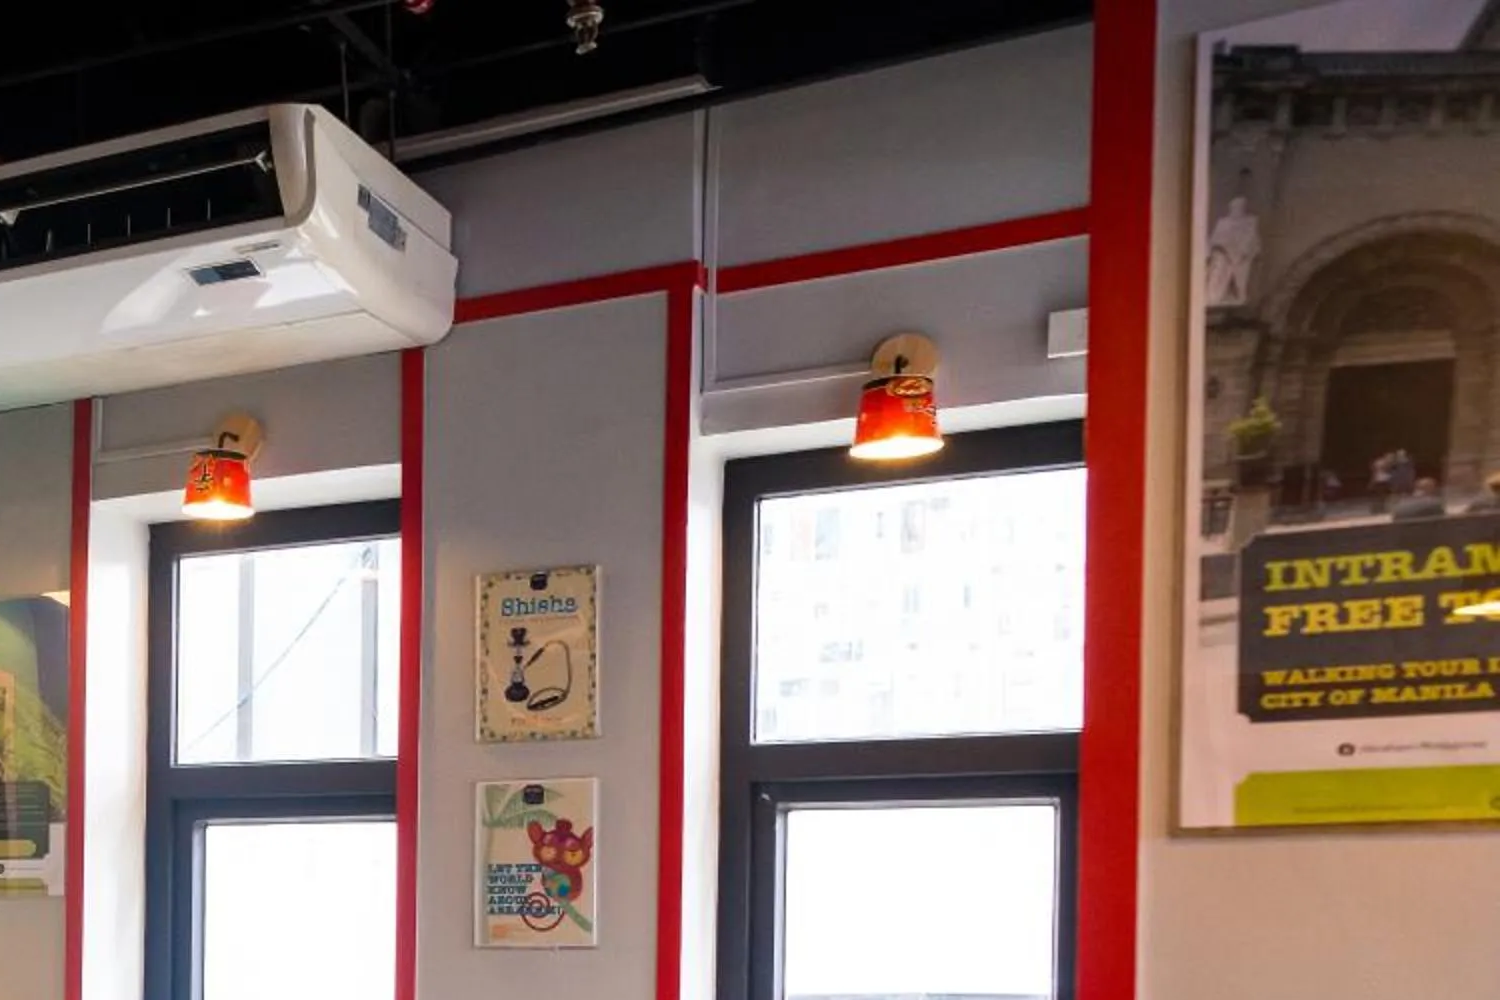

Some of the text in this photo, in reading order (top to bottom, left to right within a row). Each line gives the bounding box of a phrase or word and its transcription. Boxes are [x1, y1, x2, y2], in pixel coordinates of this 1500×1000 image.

[1262, 594, 1425, 637] FREE
[1260, 663, 1396, 686] WALKING
[1401, 658, 1480, 678] TOUR
[1259, 681, 1496, 710] CITY OF MANILA
